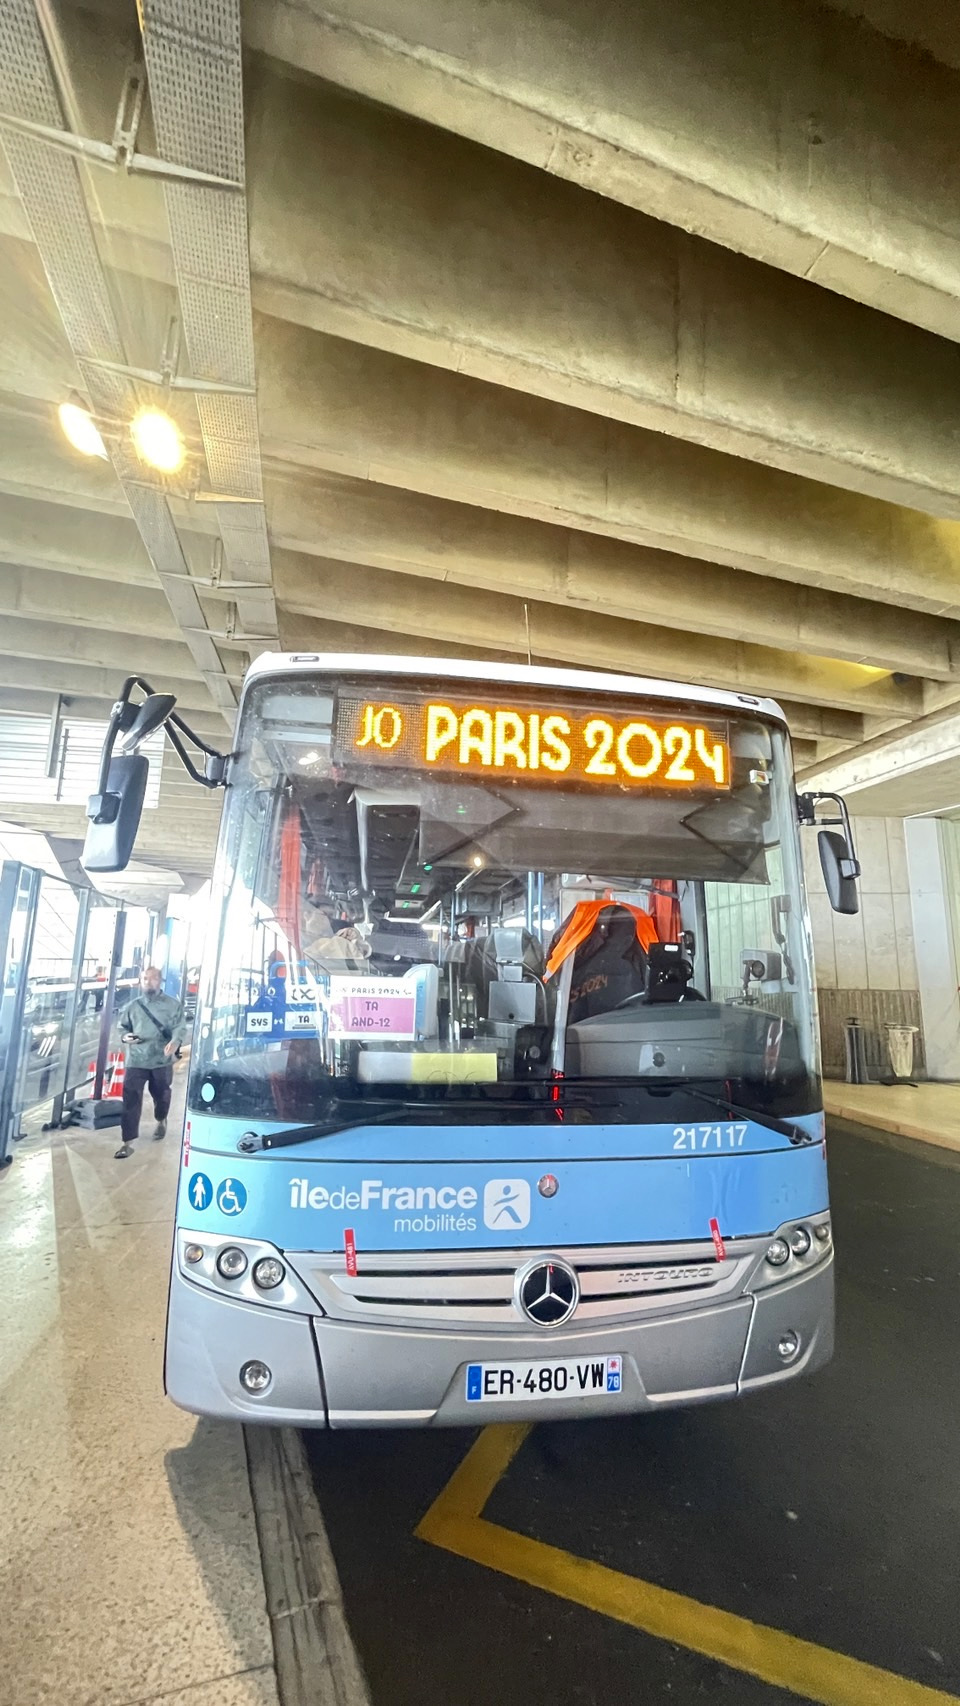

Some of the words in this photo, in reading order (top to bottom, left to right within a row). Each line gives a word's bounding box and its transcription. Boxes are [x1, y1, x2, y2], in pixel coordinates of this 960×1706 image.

[356, 706, 401, 748] JO
[425, 704, 572, 772] PARIS
[584, 719, 725, 784] 2024
[365, 1001, 379, 1011] TA
[298, 1015, 310, 1024] TA
[351, 1016, 391, 1028] AND-12
[672, 1124, 748, 1150] 217117
[394, 1213, 477, 1232] mobilités
[617, 1267, 714, 1283] INTOURO
[471, 1385, 477, 1394] F
[483, 1362, 605, 1396] ER-480-VW
[607, 1375, 620, 1389] 78
